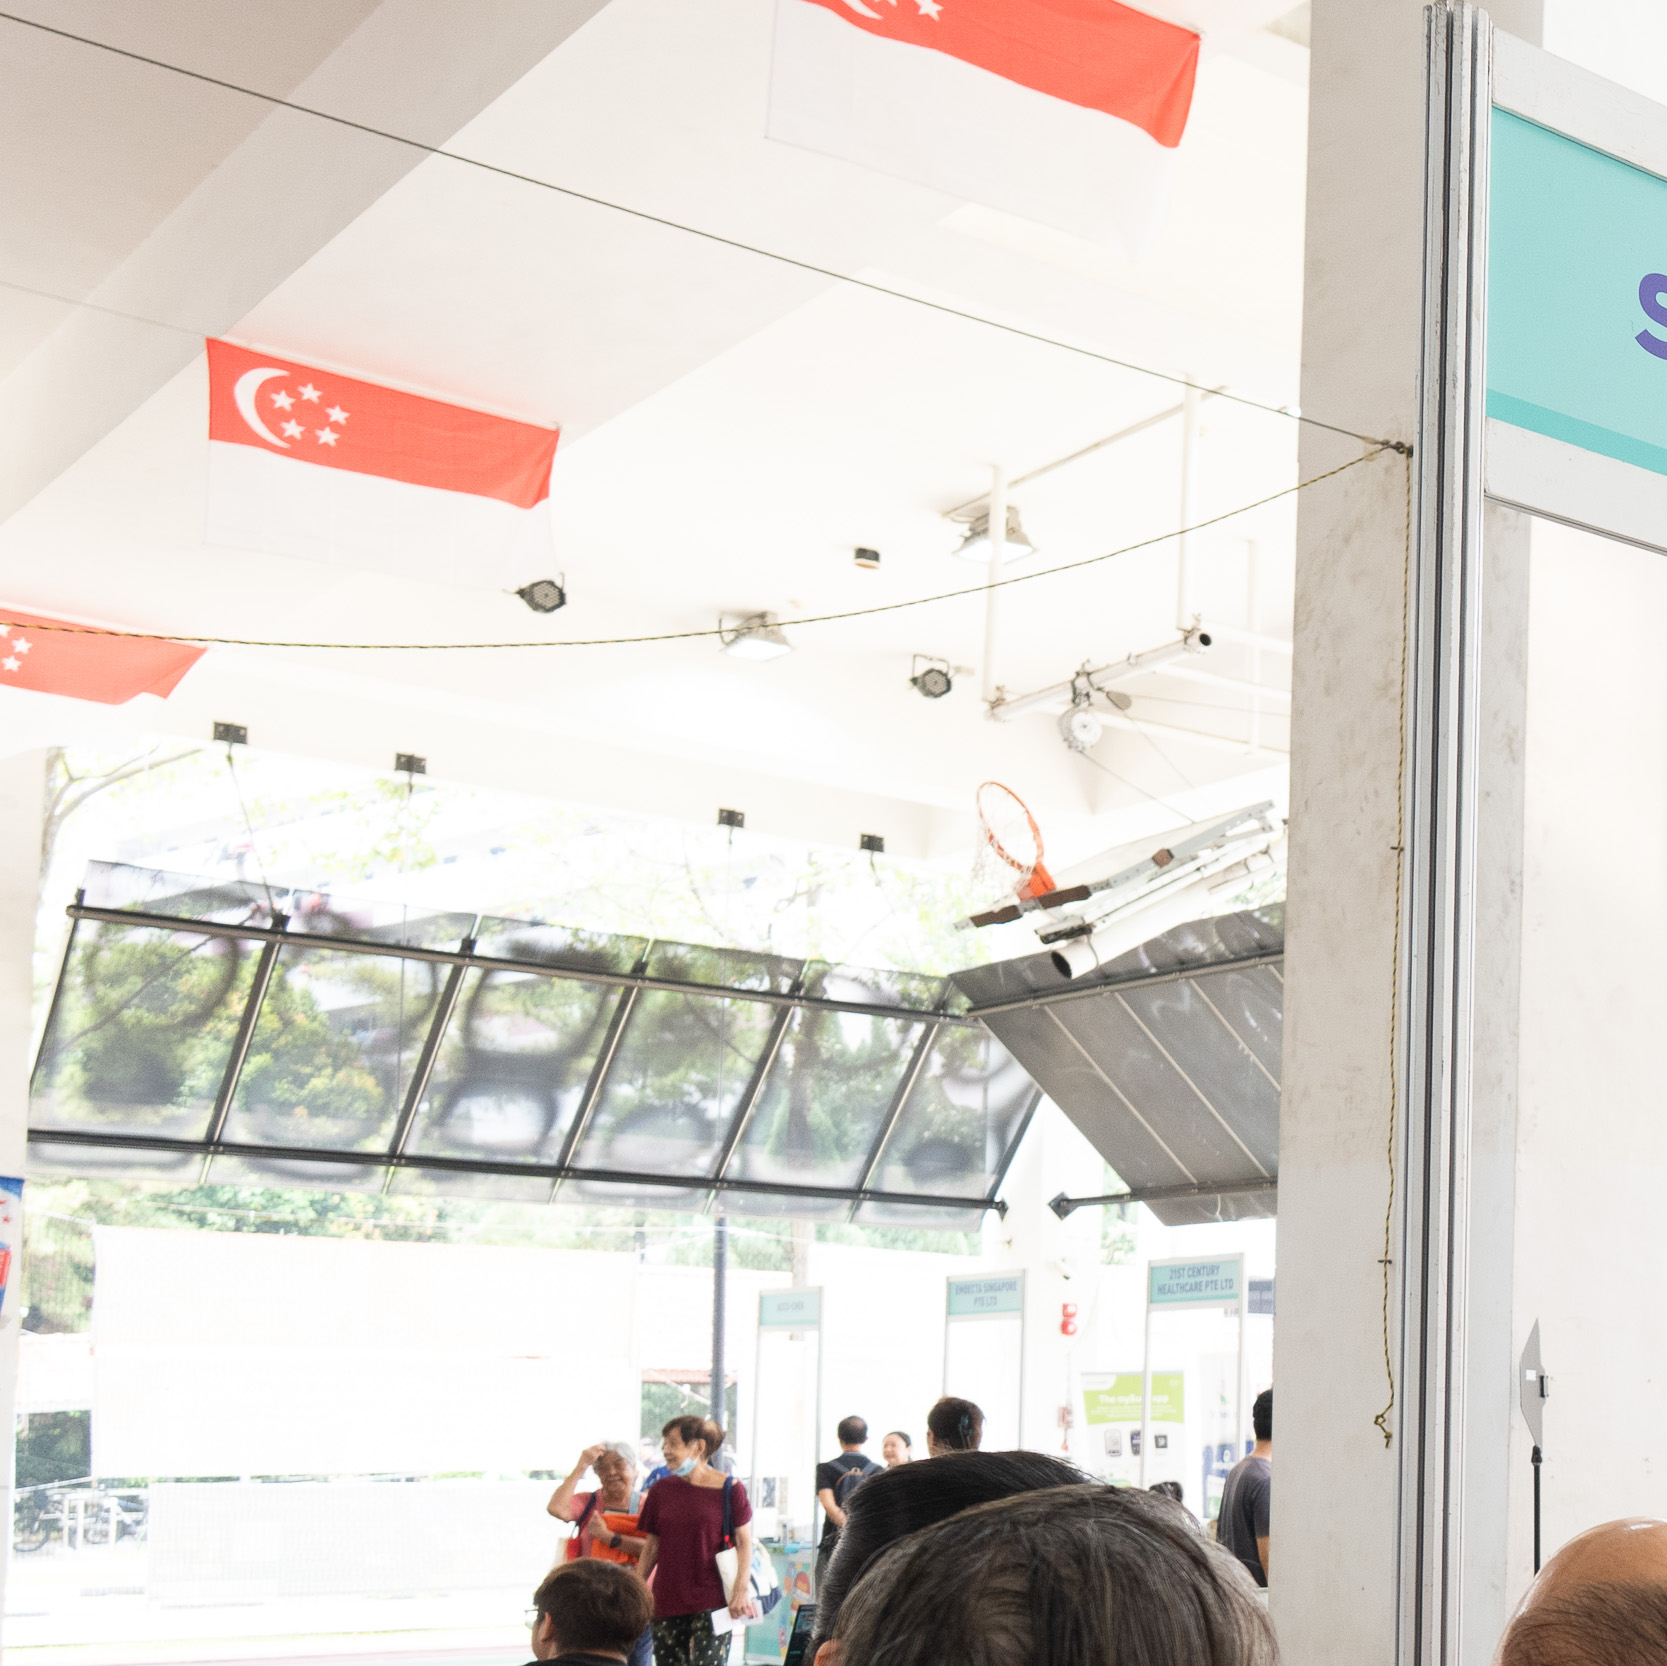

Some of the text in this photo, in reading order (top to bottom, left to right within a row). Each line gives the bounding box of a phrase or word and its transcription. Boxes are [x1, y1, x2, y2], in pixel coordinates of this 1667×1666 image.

[1169, 1265, 1220, 1279] 21ST CENTURY
[983, 1281, 1017, 1293] SINGAPORE
[1157, 1280, 1233, 1295] HEALTHCARE PTE LTD
[986, 1296, 997, 1306] LTD
